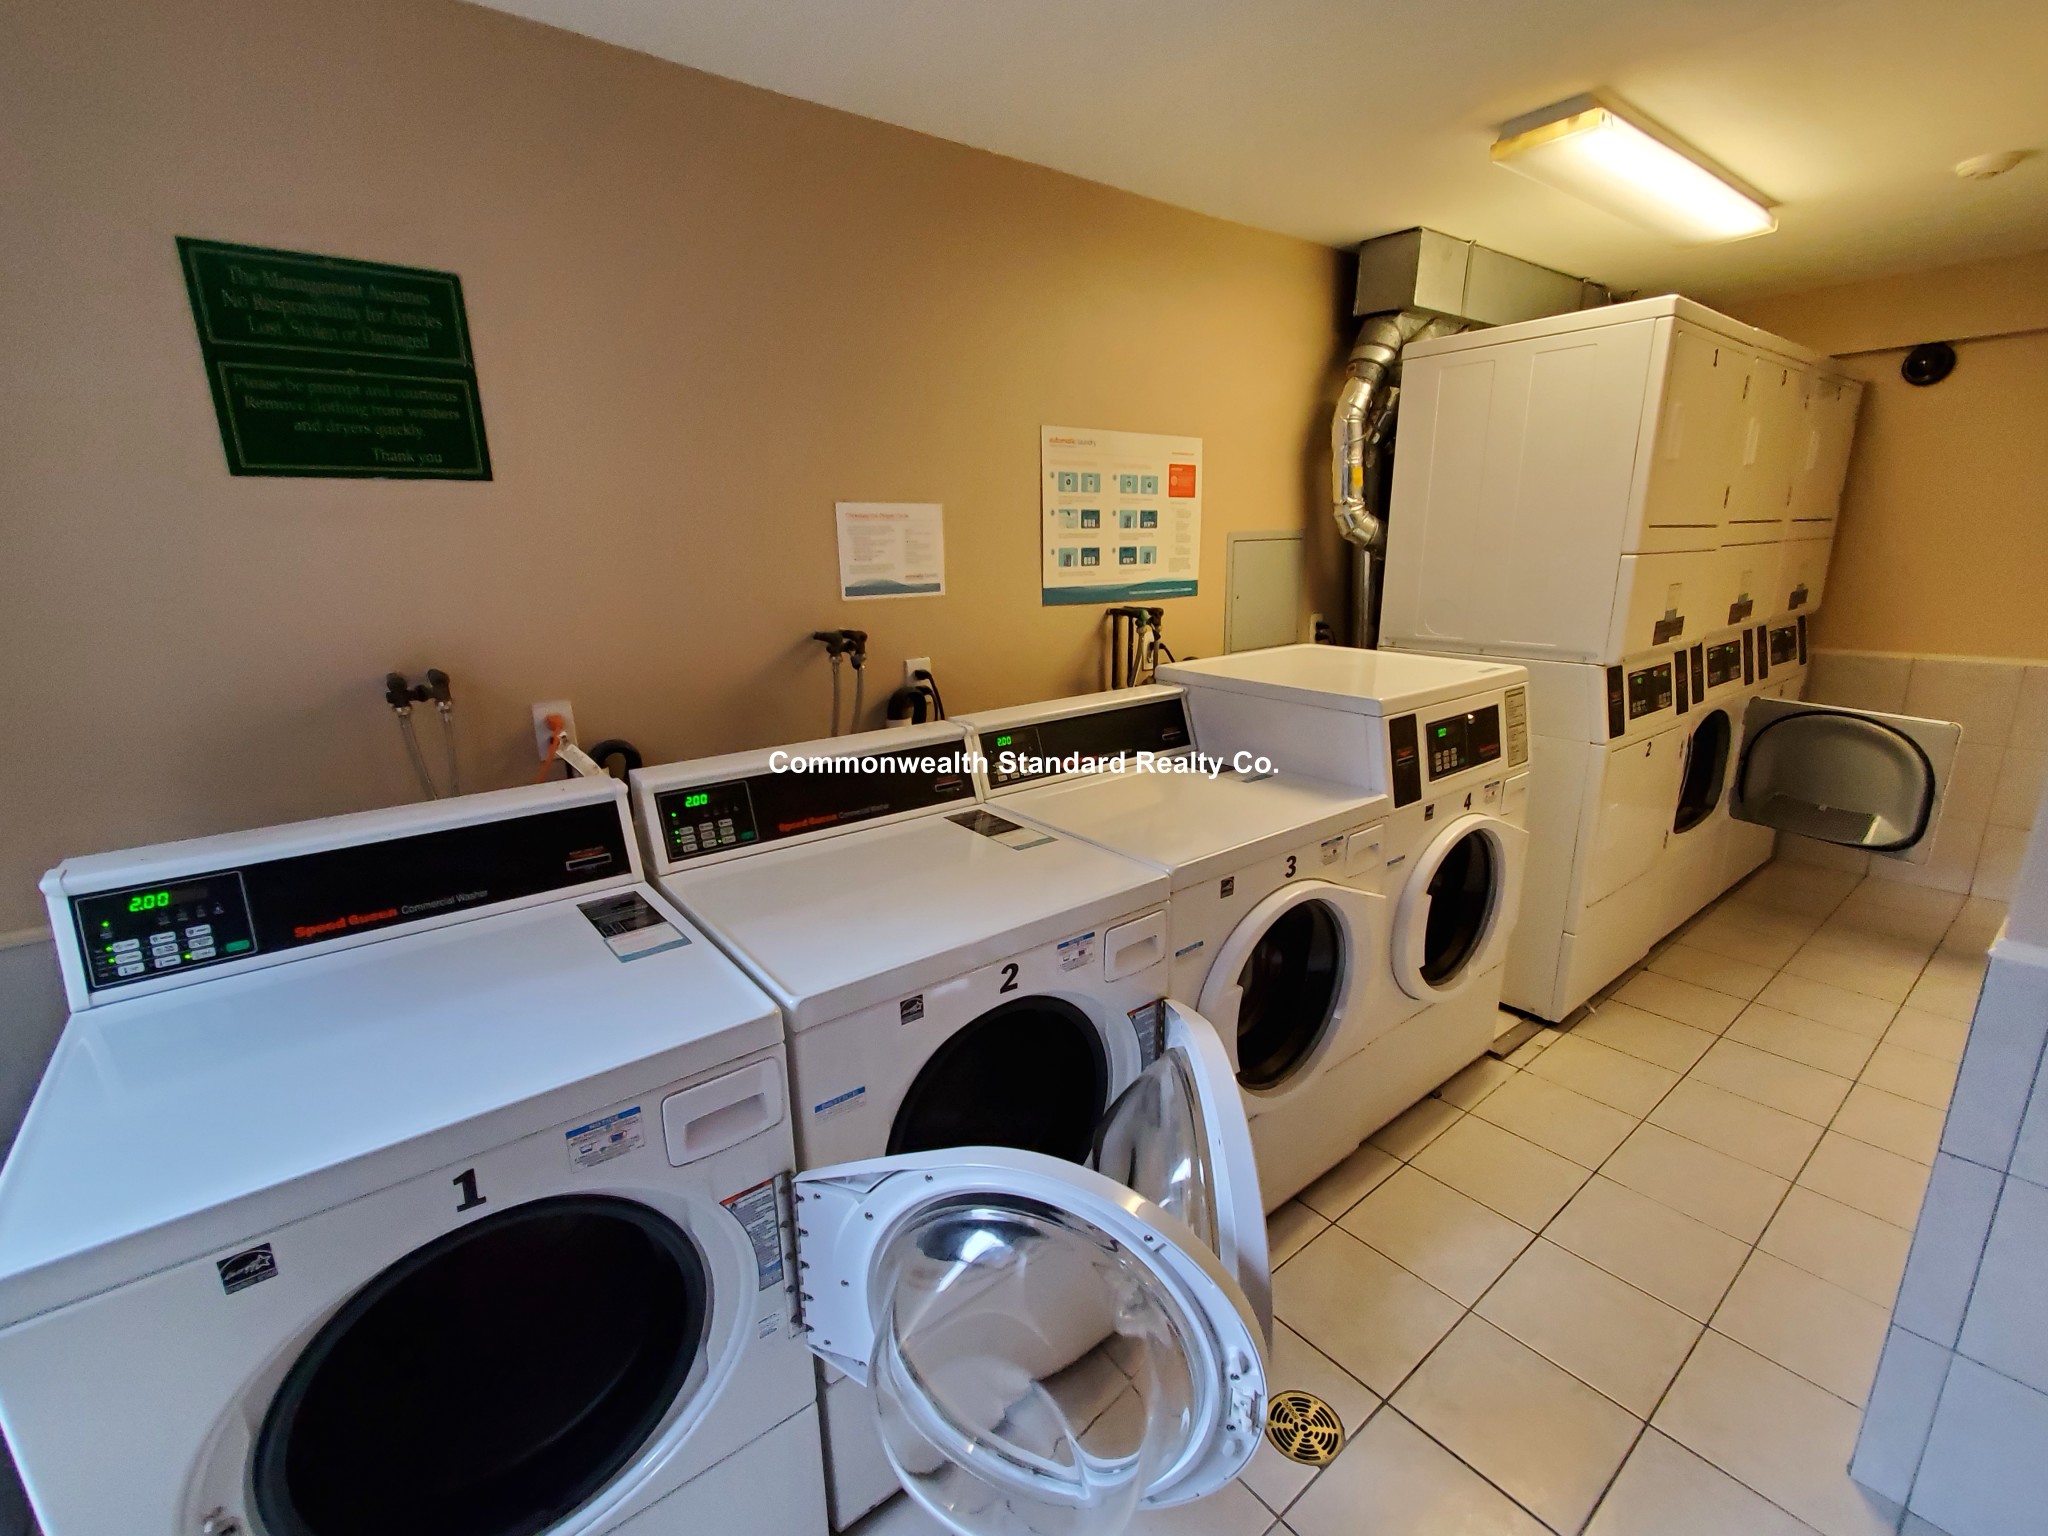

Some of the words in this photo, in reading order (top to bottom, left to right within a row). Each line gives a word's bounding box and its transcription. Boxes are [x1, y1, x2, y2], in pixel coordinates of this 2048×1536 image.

[307, 381, 361, 397] prompt
[293, 418, 320, 433] and
[372, 447, 414, 463] Thank
[418, 451, 443, 467] you
[1645, 741, 1652, 757] 2
[1463, 792, 1472, 811] 4
[1284, 855, 1297, 879] 3
[128, 891, 170, 913] 2.00
[999, 962, 1019, 995] 2
[452, 1167, 488, 1214] 1
